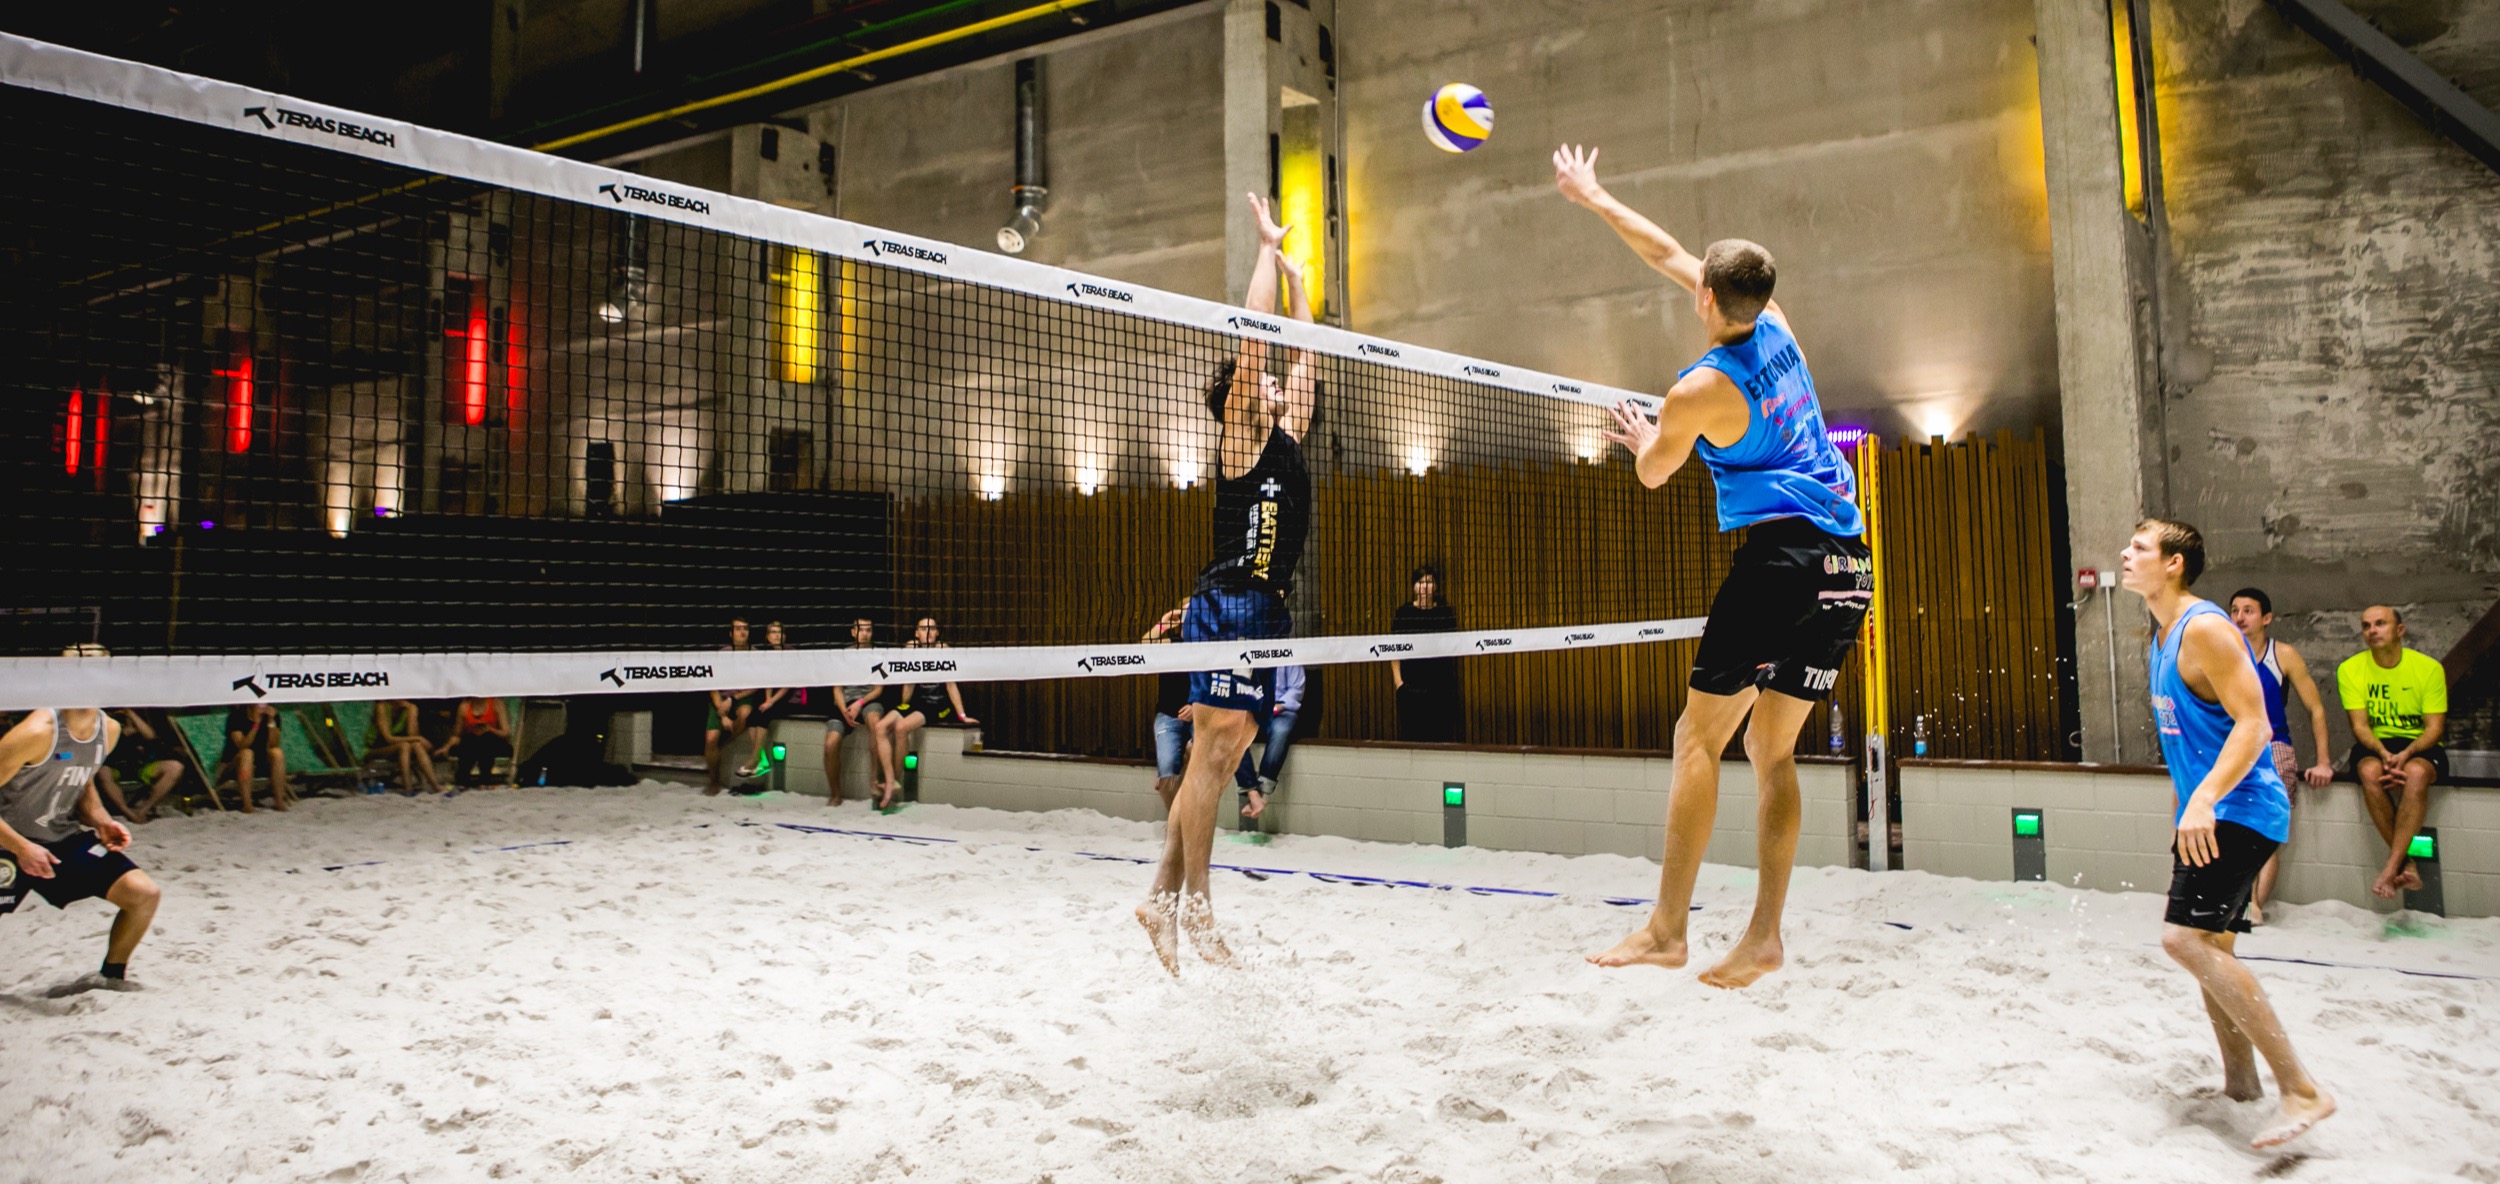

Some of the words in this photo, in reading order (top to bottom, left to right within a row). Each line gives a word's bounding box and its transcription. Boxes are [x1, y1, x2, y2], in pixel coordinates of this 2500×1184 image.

[276, 108, 336, 133] TERAS
[338, 121, 396, 149] BEACH
[624, 185, 666, 205] TERAS
[668, 195, 710, 215] BEACH
[882, 241, 914, 257] TERAS
[915, 248, 946, 265] BEACH
[1082, 284, 1107, 297] TERAS
[1108, 289, 1132, 303] BEACH
[1241, 317, 1259, 329] TERAS
[1260, 322, 1281, 333] BEACH
[1367, 344, 1384, 354] TERAS
[1744, 344, 1800, 401] ESTONIA
[1091, 656, 1116, 666] TERAS
[1117, 655, 1145, 665] BEACH
[1250, 650, 1270, 659] TERAS
[1271, 649, 1293, 658] BEACH
[624, 666, 668, 679] TERAS
[669, 665, 713, 678] BEACH
[888, 661, 921, 672] TERAS
[922, 661, 956, 672] BEACH
[265, 673, 325, 688] TERAS
[327, 672, 389, 687] BEACH
[1211, 686, 1230, 698] FIN
[2367, 684, 2390, 699] WE
[2366, 701, 2398, 716] RUN
[57, 766, 92, 786] FIN
